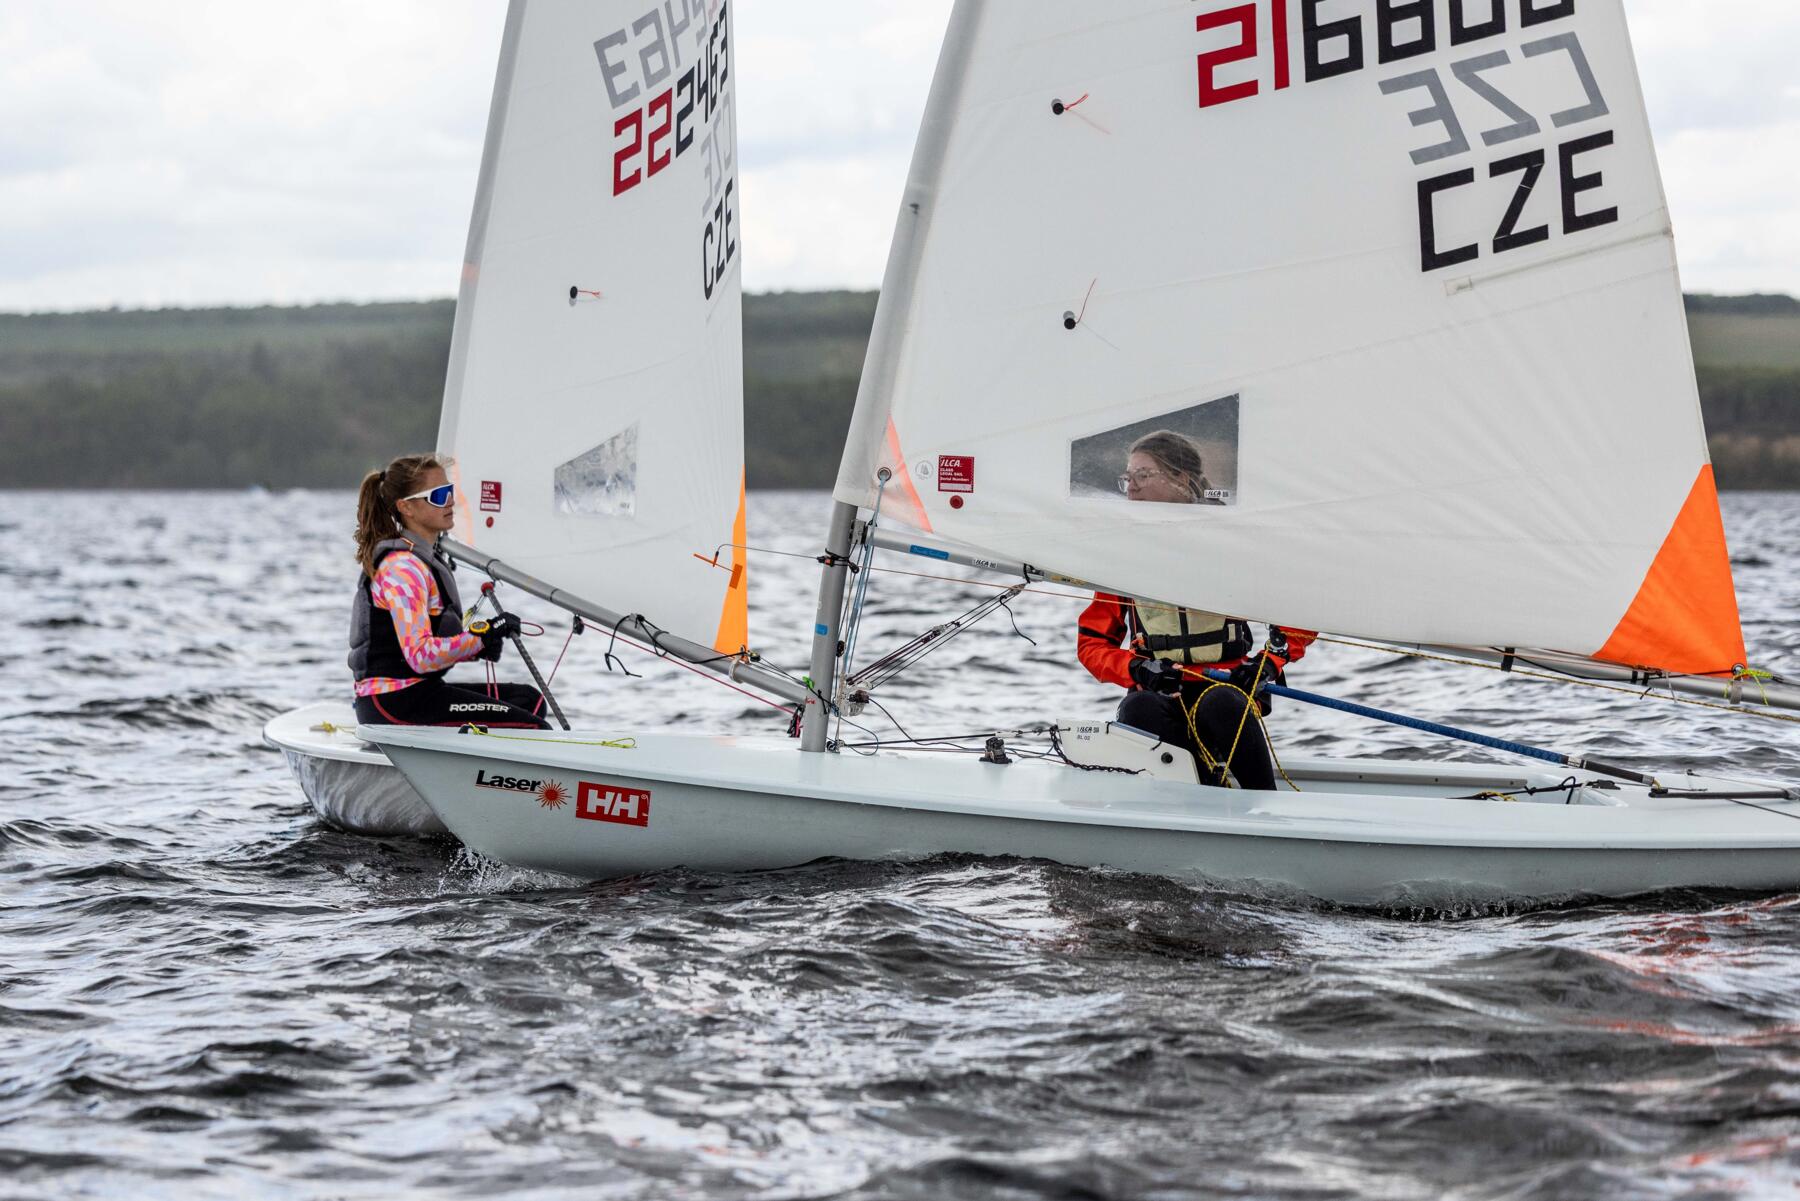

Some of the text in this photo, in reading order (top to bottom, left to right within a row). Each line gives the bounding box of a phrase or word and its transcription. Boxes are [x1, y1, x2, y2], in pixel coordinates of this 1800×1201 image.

[1196, 0, 1575, 108] 2168
[1417, 130, 1618, 272] CZE
[703, 177, 735, 300] CZE
[940, 459, 961, 467] ILCA
[449, 703, 510, 713] ROOSTER
[476, 770, 541, 792] Laser
[587, 789, 640, 819] HH
